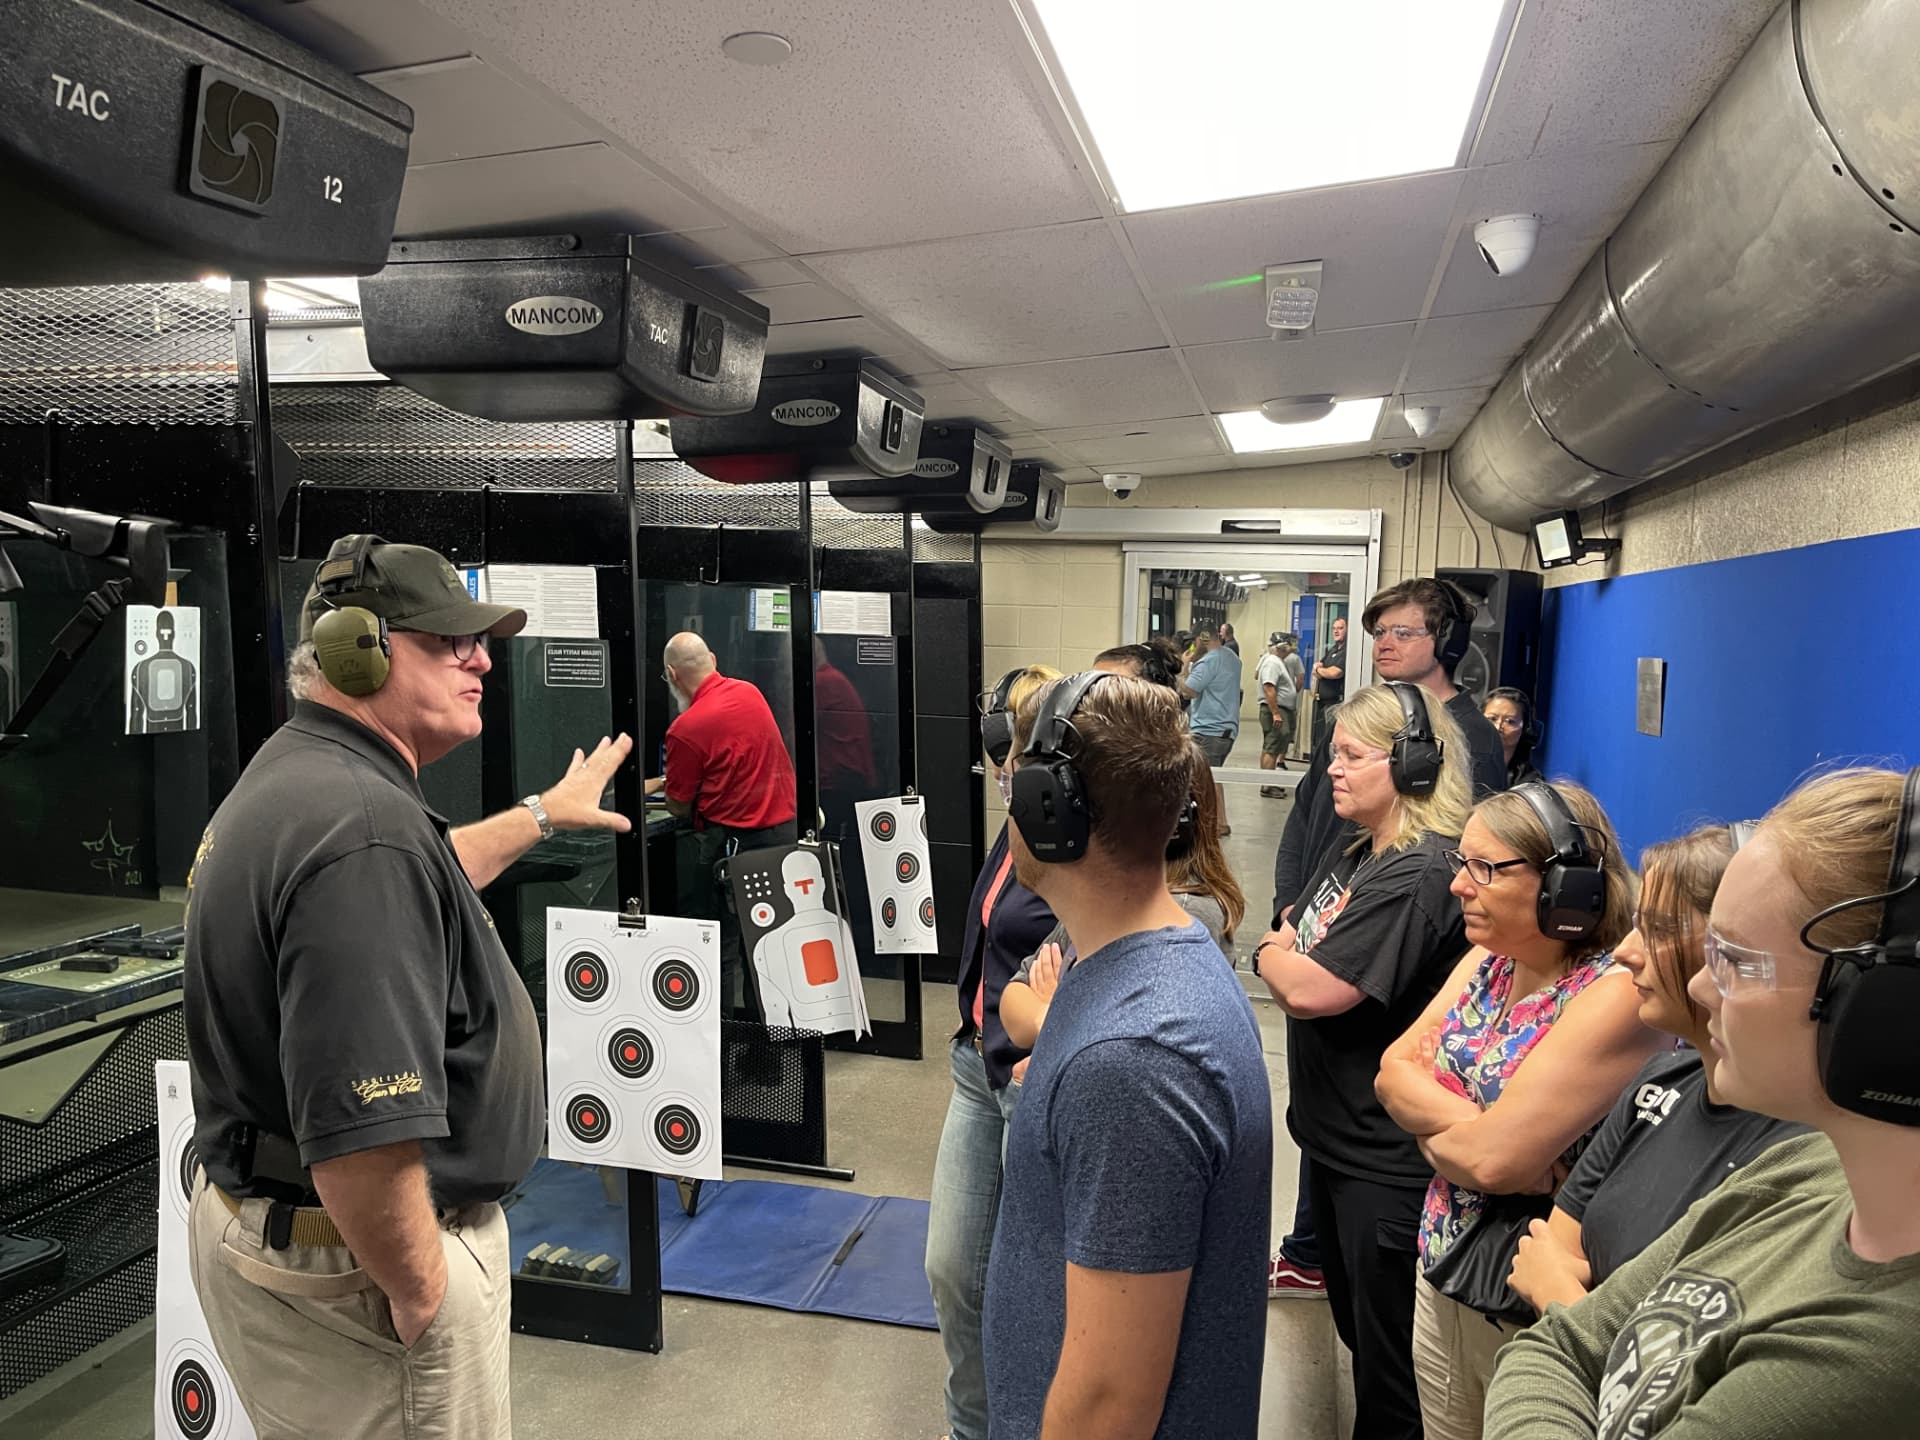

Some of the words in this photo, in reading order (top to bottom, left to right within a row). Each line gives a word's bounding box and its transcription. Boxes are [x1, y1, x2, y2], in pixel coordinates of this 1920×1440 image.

[51, 73, 110, 121] TAC
[323, 175, 343, 203] 12
[511, 307, 598, 325] MANCOM
[650, 323, 669, 345] TAC
[775, 406, 837, 420] MANCOM
